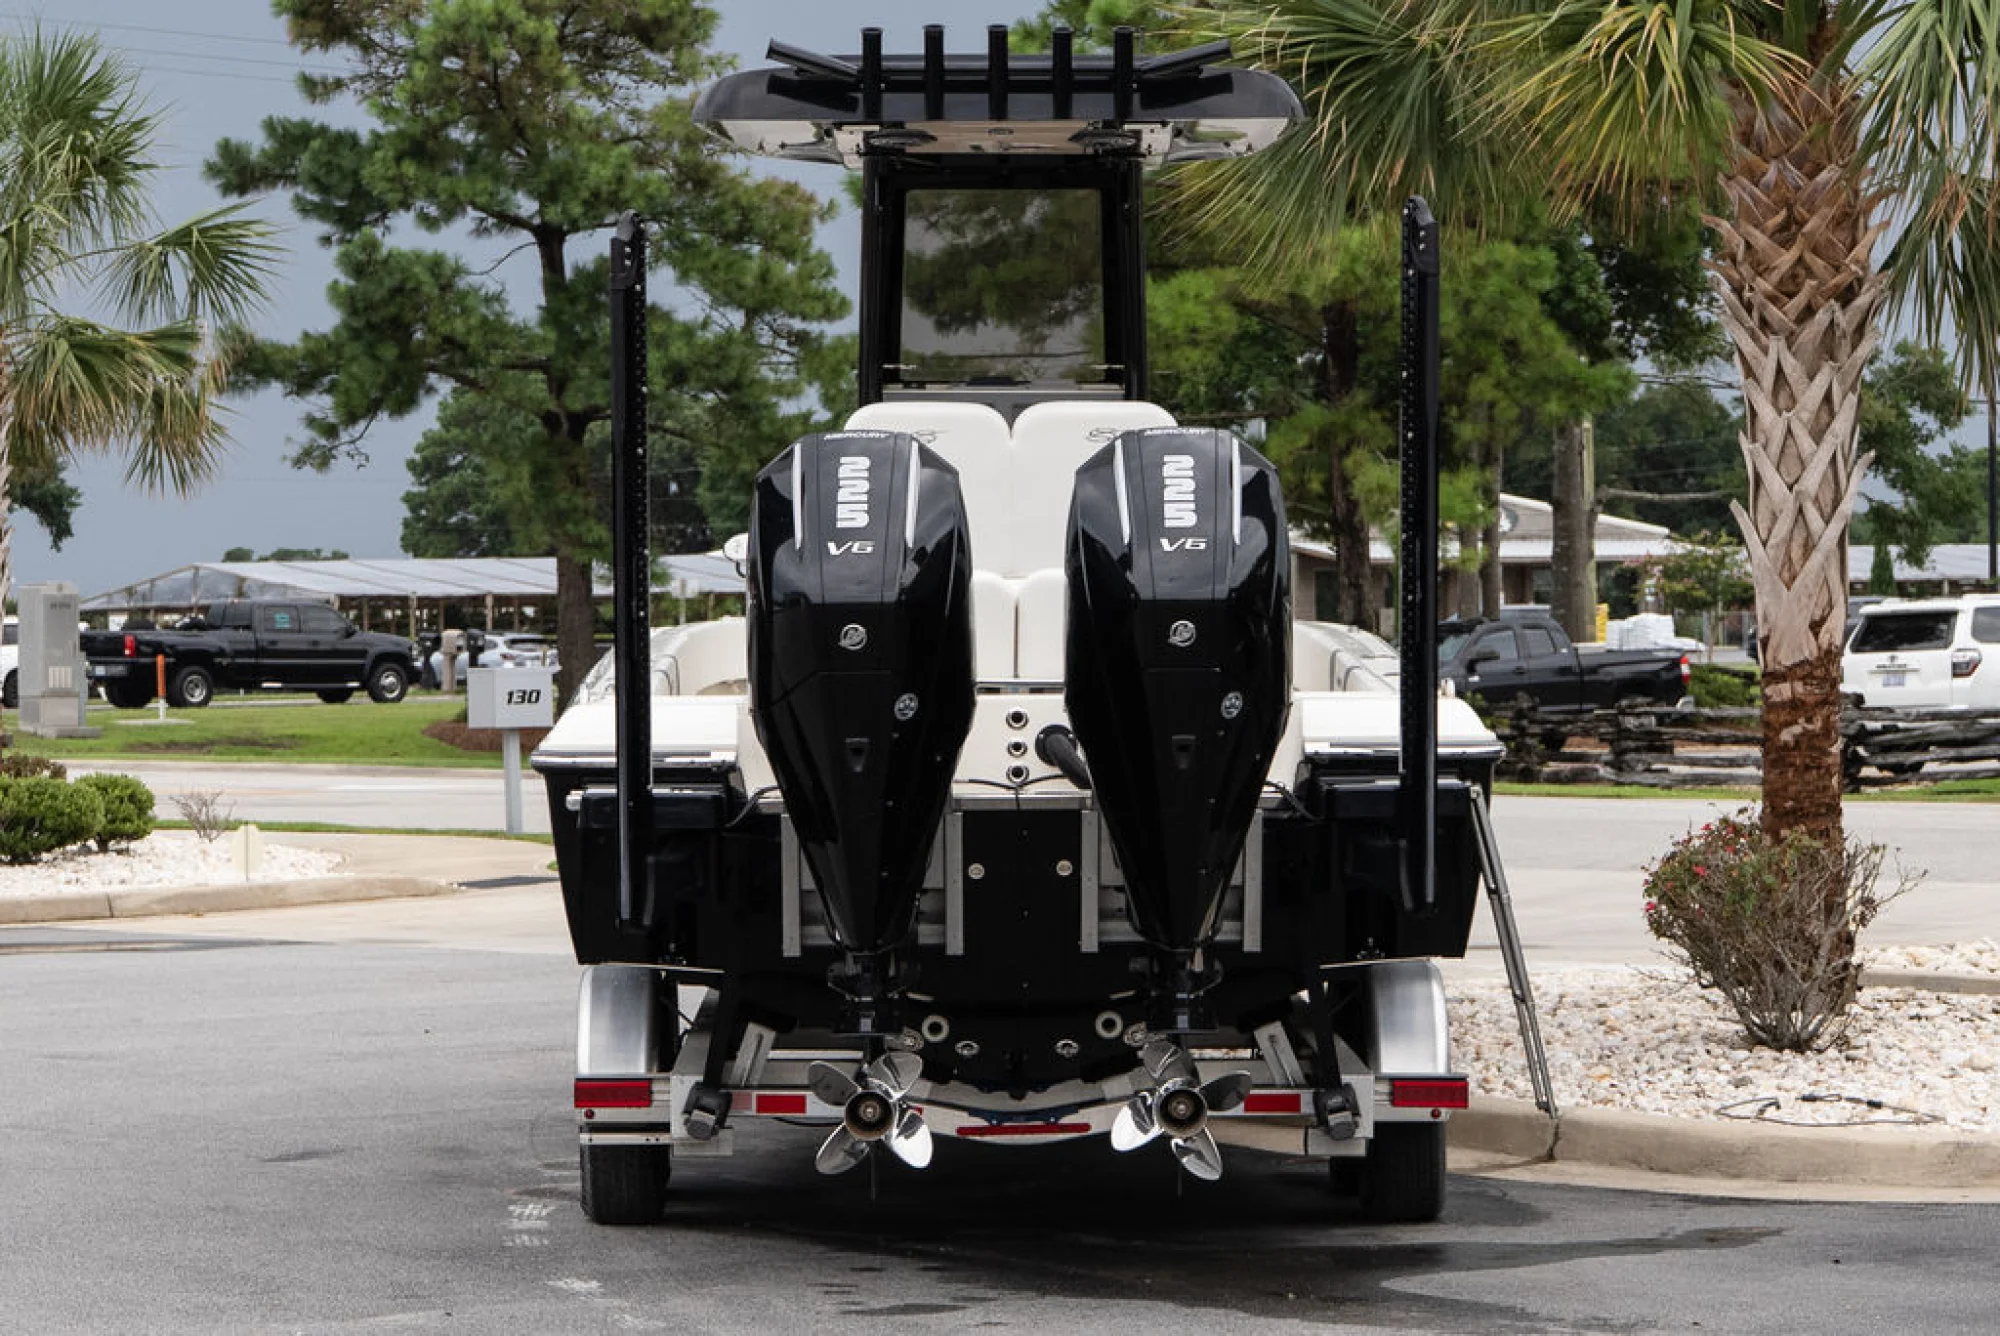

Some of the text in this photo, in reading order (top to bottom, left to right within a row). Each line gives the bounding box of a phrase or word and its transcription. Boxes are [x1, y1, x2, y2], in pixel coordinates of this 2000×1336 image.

[836, 456, 871, 528] 225
[1162, 454, 1197, 528] 225
[827, 541, 875, 556] V6
[1160, 537, 1207, 552] V6
[507, 689, 541, 705] 130
